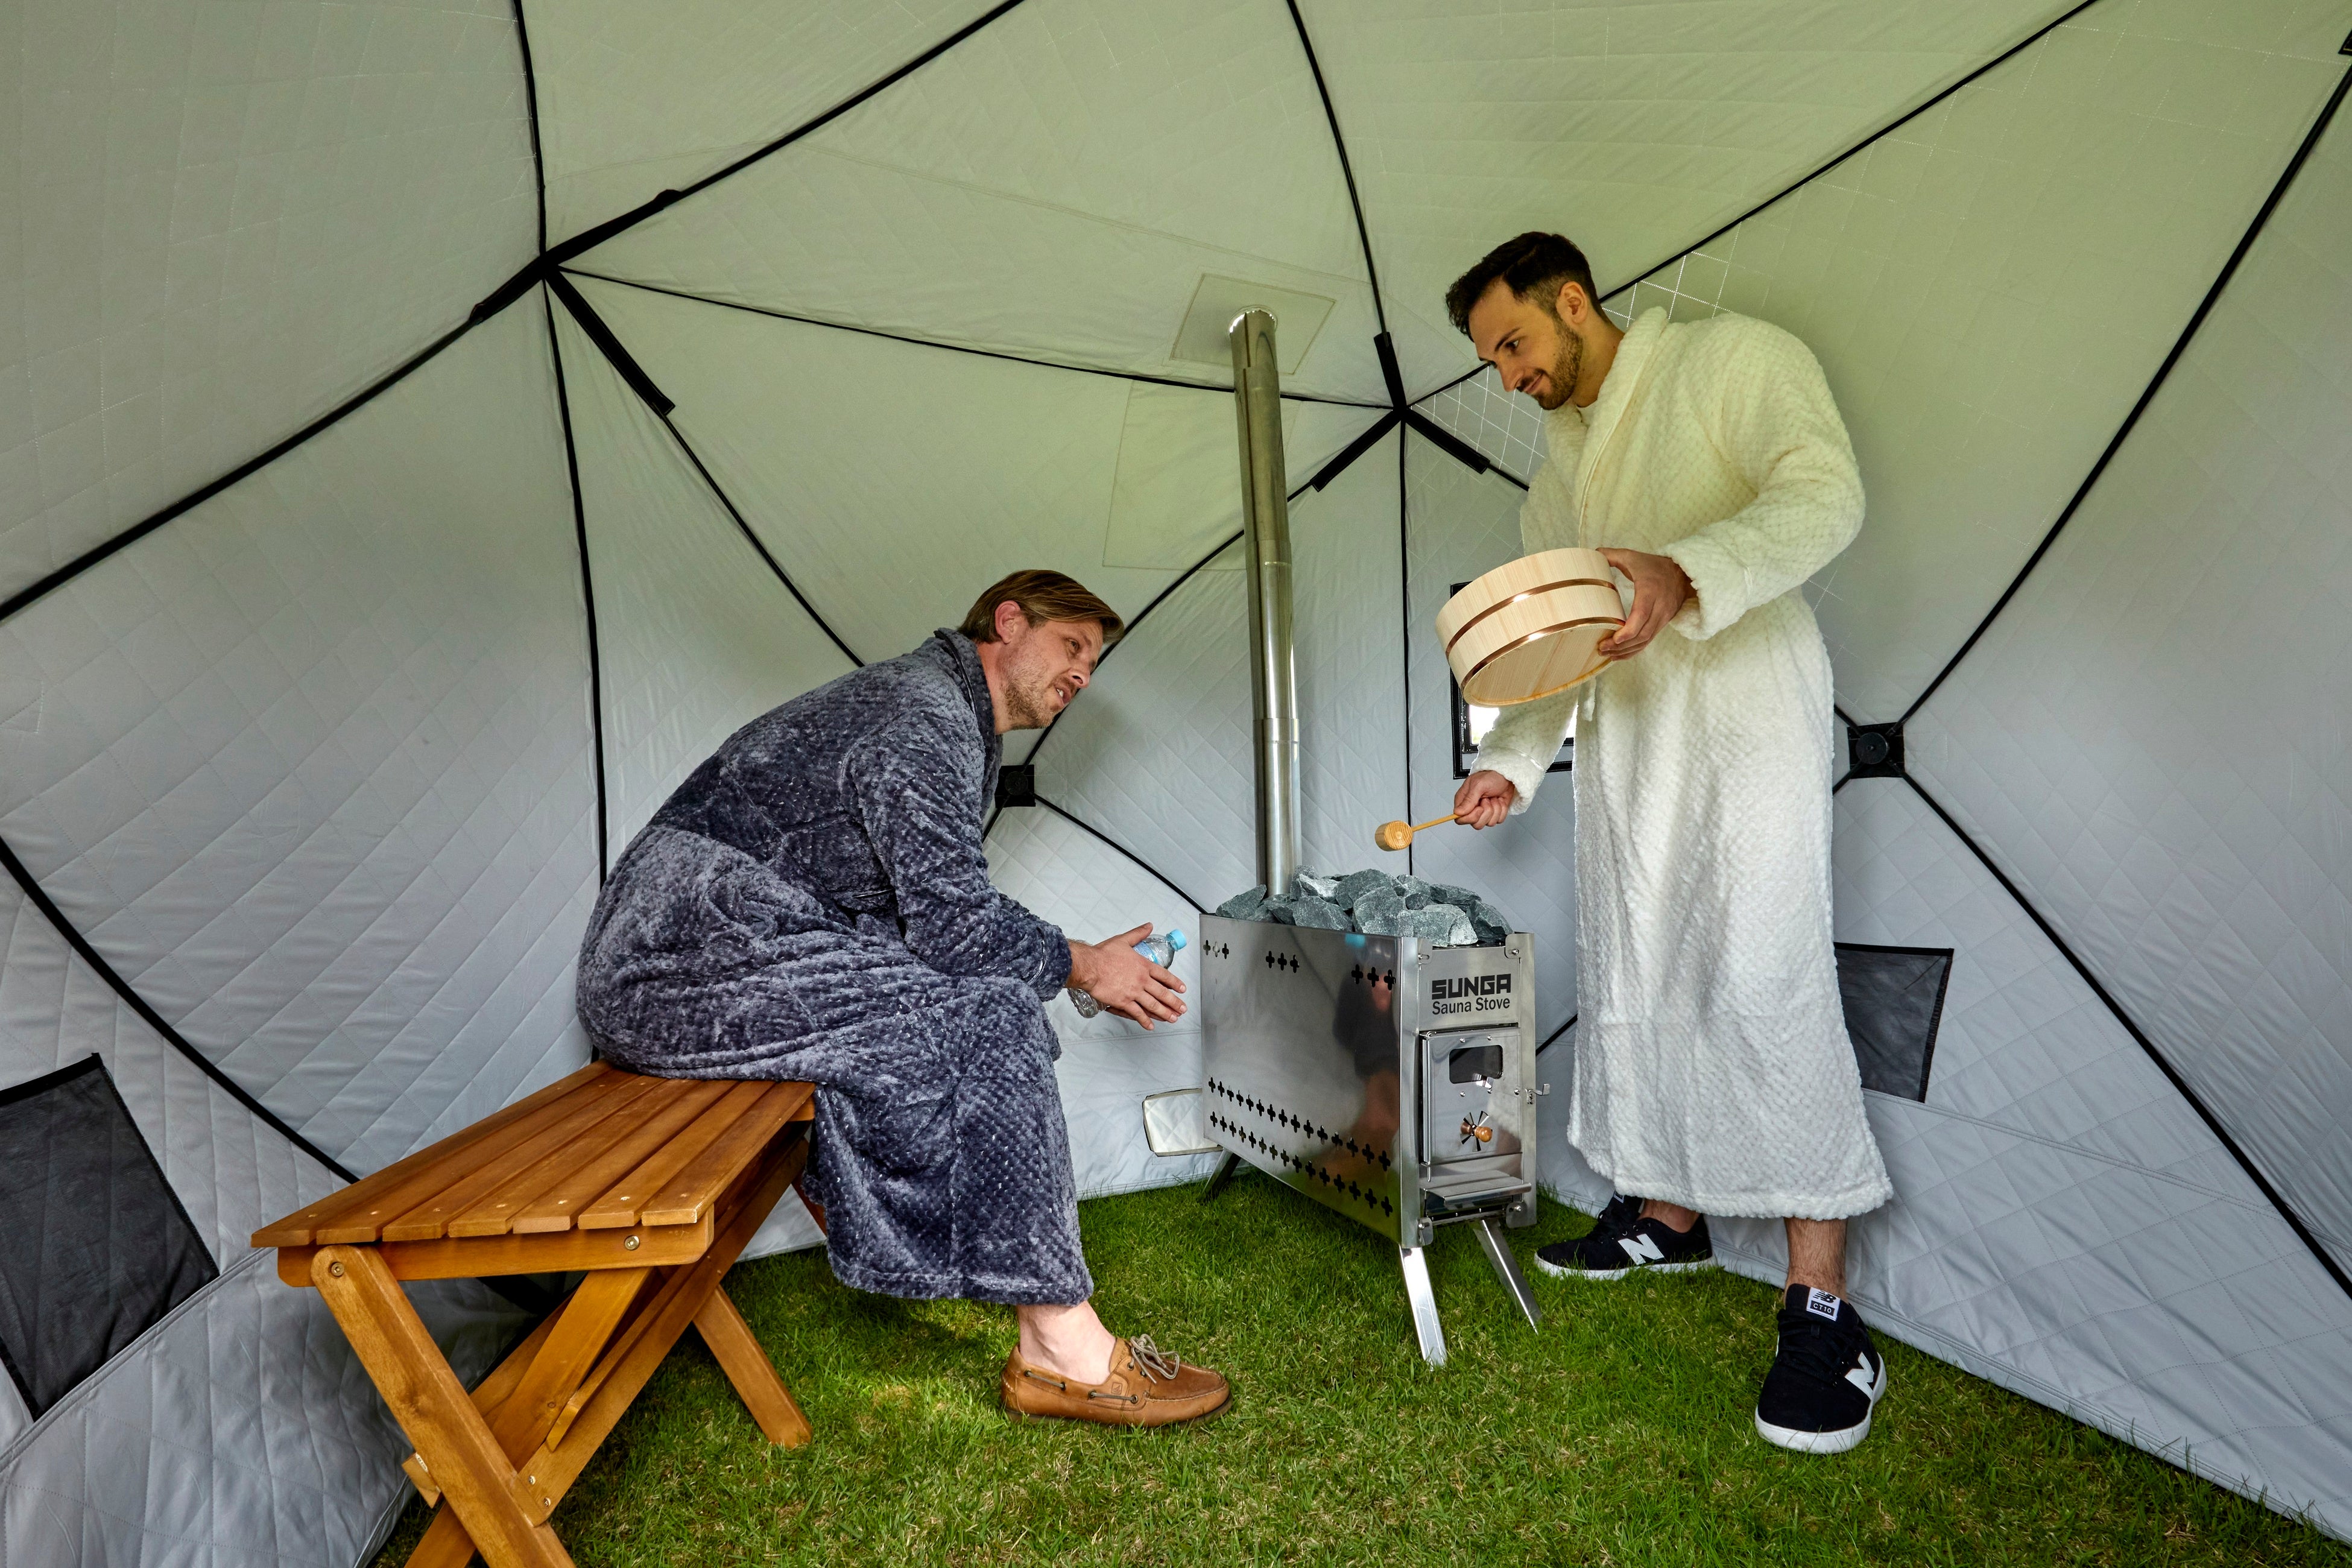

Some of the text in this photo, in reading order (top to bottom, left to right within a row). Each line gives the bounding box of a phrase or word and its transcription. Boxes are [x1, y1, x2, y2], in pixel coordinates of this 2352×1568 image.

[1432, 973, 1511, 1000] SUNGA
[1432, 997, 1510, 1015] Sauna Stove
[1617, 1233, 1664, 1265] N
[1813, 1303, 1832, 1314] CT10
